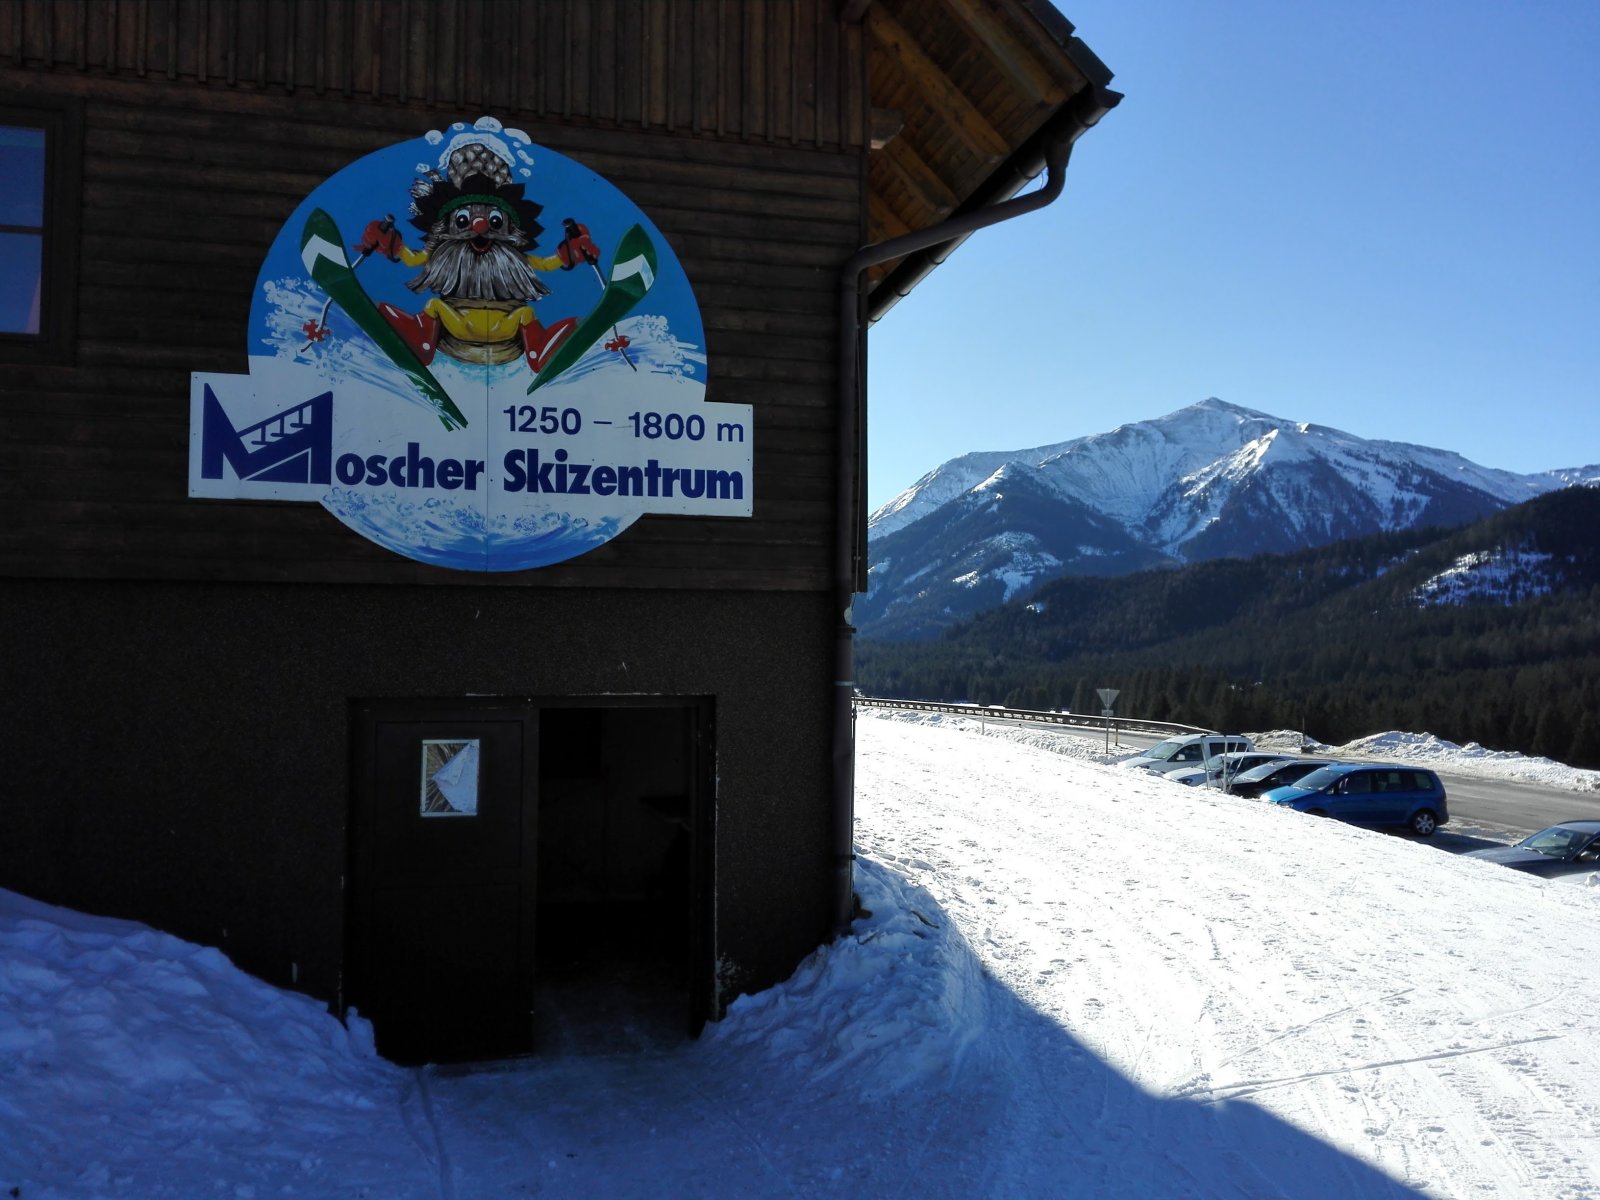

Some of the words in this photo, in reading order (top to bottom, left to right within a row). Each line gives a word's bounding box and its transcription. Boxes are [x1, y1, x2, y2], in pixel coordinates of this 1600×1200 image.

[503, 405, 582, 436] 1250
[628, 411, 706, 441] 1800
[717, 422, 744, 443] m
[503, 448, 744, 500] Skizentrum
